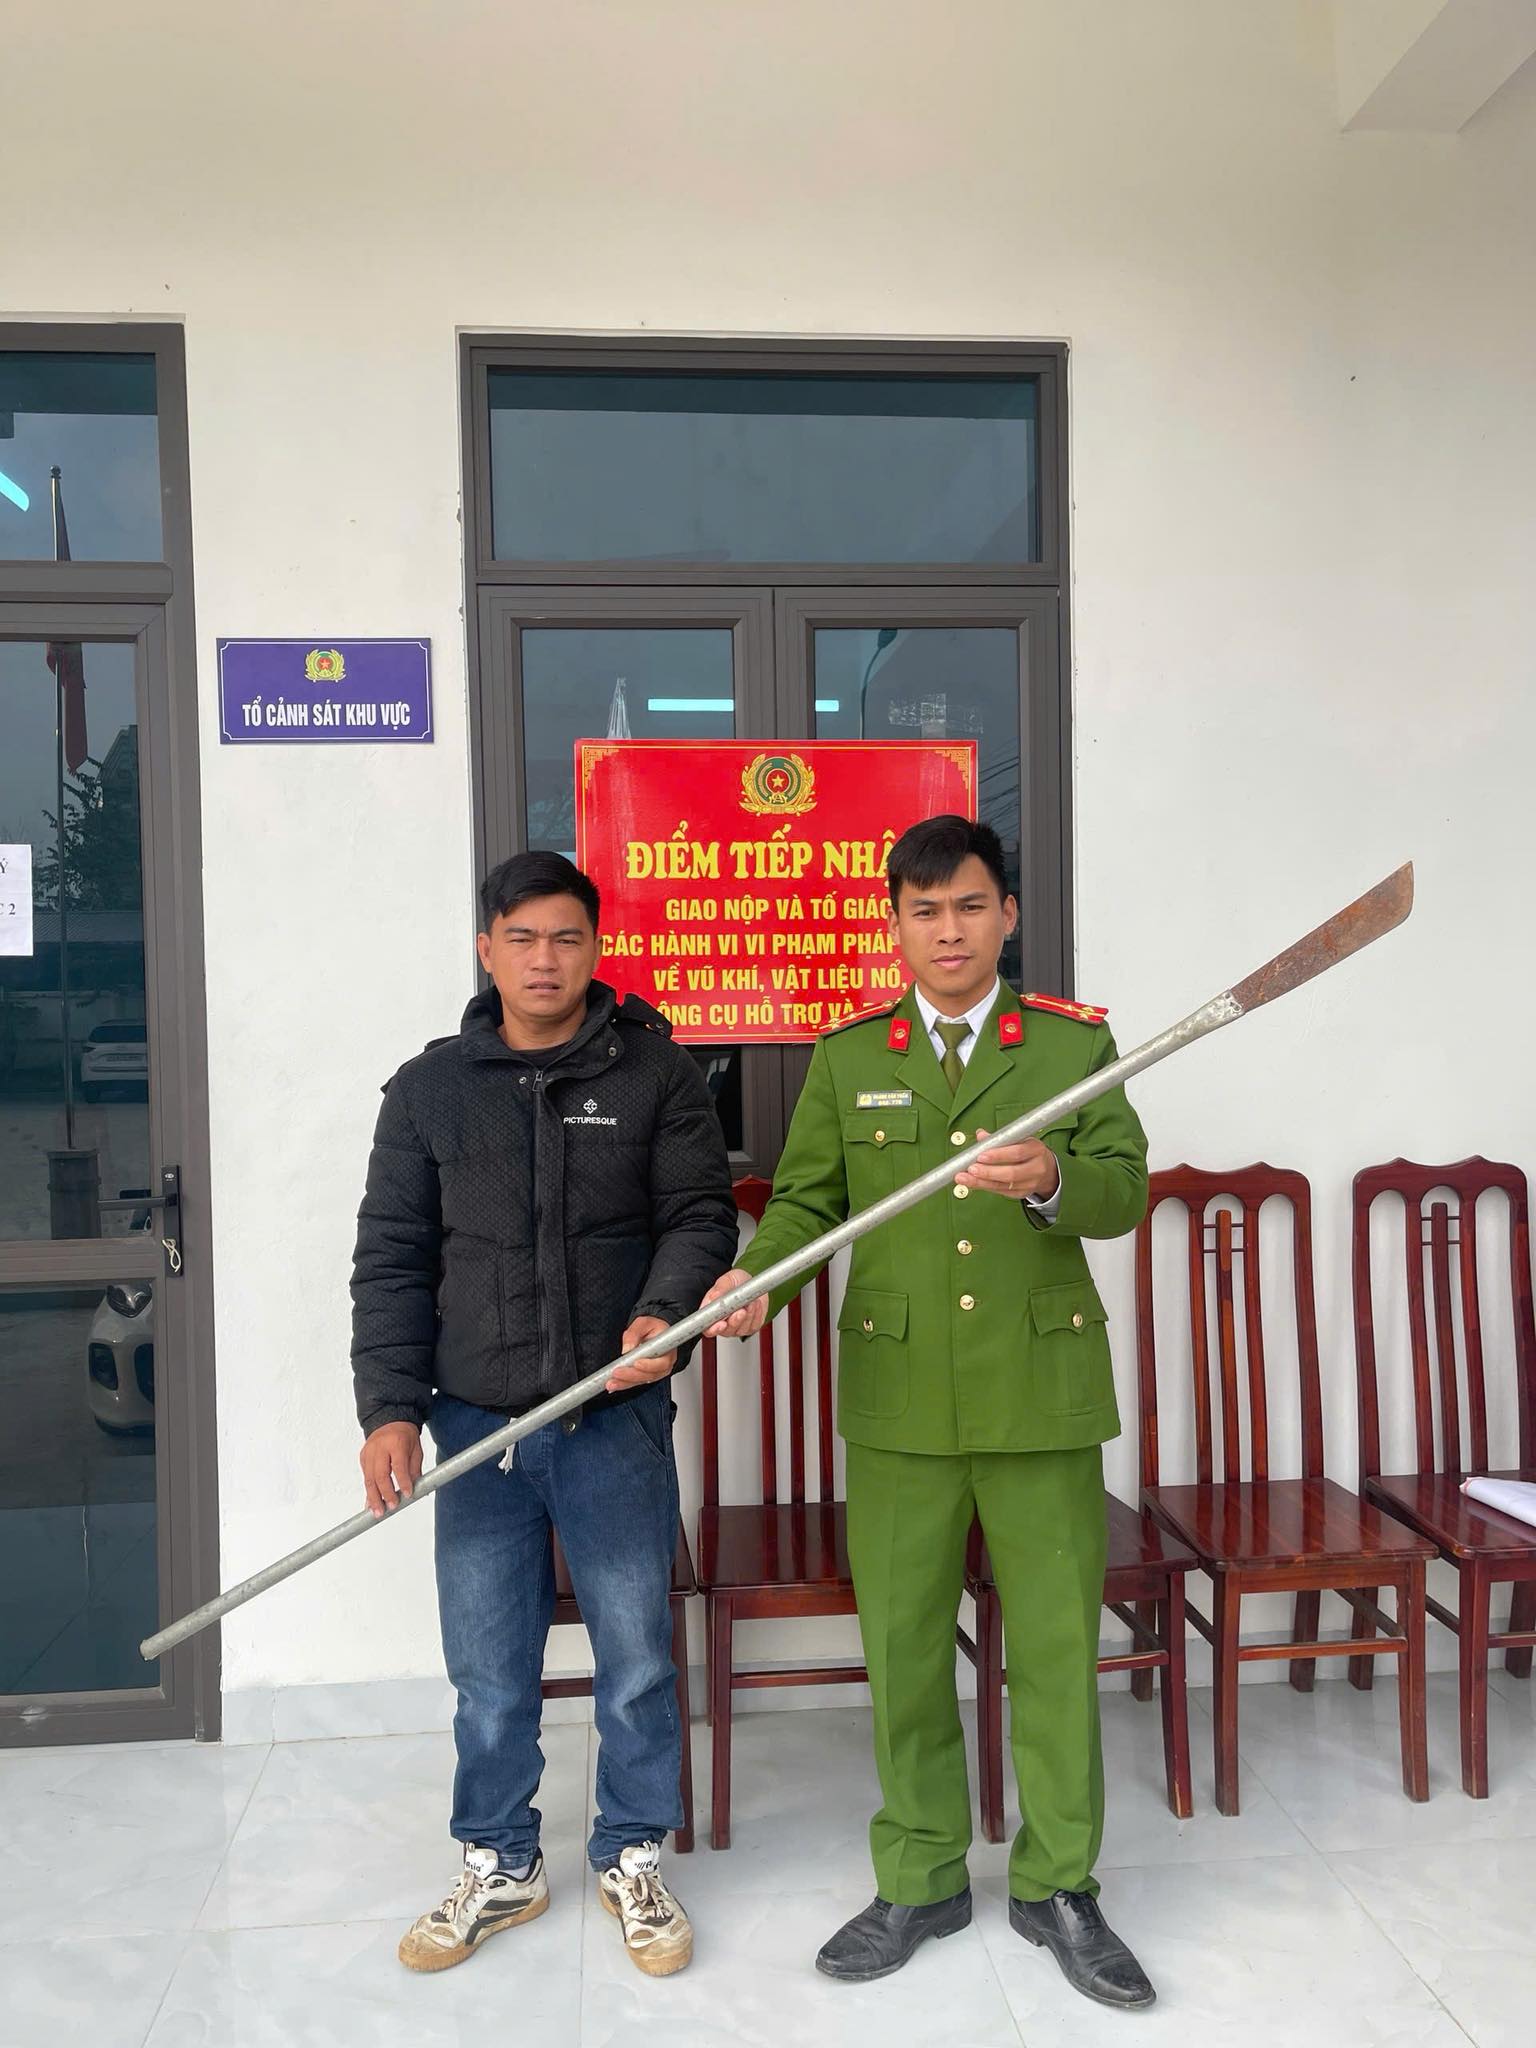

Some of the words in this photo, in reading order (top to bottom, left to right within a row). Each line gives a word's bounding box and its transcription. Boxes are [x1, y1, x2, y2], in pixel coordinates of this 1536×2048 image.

[242, 695, 262, 727] TỔ
[265, 696, 308, 727] CẢNH
[312, 699, 342, 726] SÁT
[346, 703, 377, 726] KHU
[380, 701, 411, 731] VỰC
[626, 820, 720, 879] ĐIỂM
[729, 823, 813, 879] TIẾP
[822, 829, 896, 887] NHẬ
[9, 903, 16, 915] 2
[665, 898, 717, 921] GIAO
[724, 894, 769, 925] NỘP
[775, 894, 804, 920] VÀ
[810, 890, 837, 920] TỐ
[843, 893, 892, 920] GIÁC
[601, 930, 643, 956] CÁC
[650, 930, 711, 956] HÀNH
[718, 934, 738, 956] VI
[745, 934, 765, 956] VI
[772, 933, 836, 959] PHẠM
[653, 962, 680, 991] VỀ
[687, 965, 715, 991] VŨ
[722, 964, 765, 992] KHÍ,
[771, 964, 811, 994] VẬT
[817, 963, 864, 994] LIỆU
[870, 959, 907, 991] NỔ,
[655, 1000, 702, 1026] ÔNG
[709, 1004, 738, 1030] CỤ
[745, 996, 774, 1026] HỖ
[780, 1002, 823, 1029] TRỢ
[563, 1116, 618, 1126] PICTURESQUE
